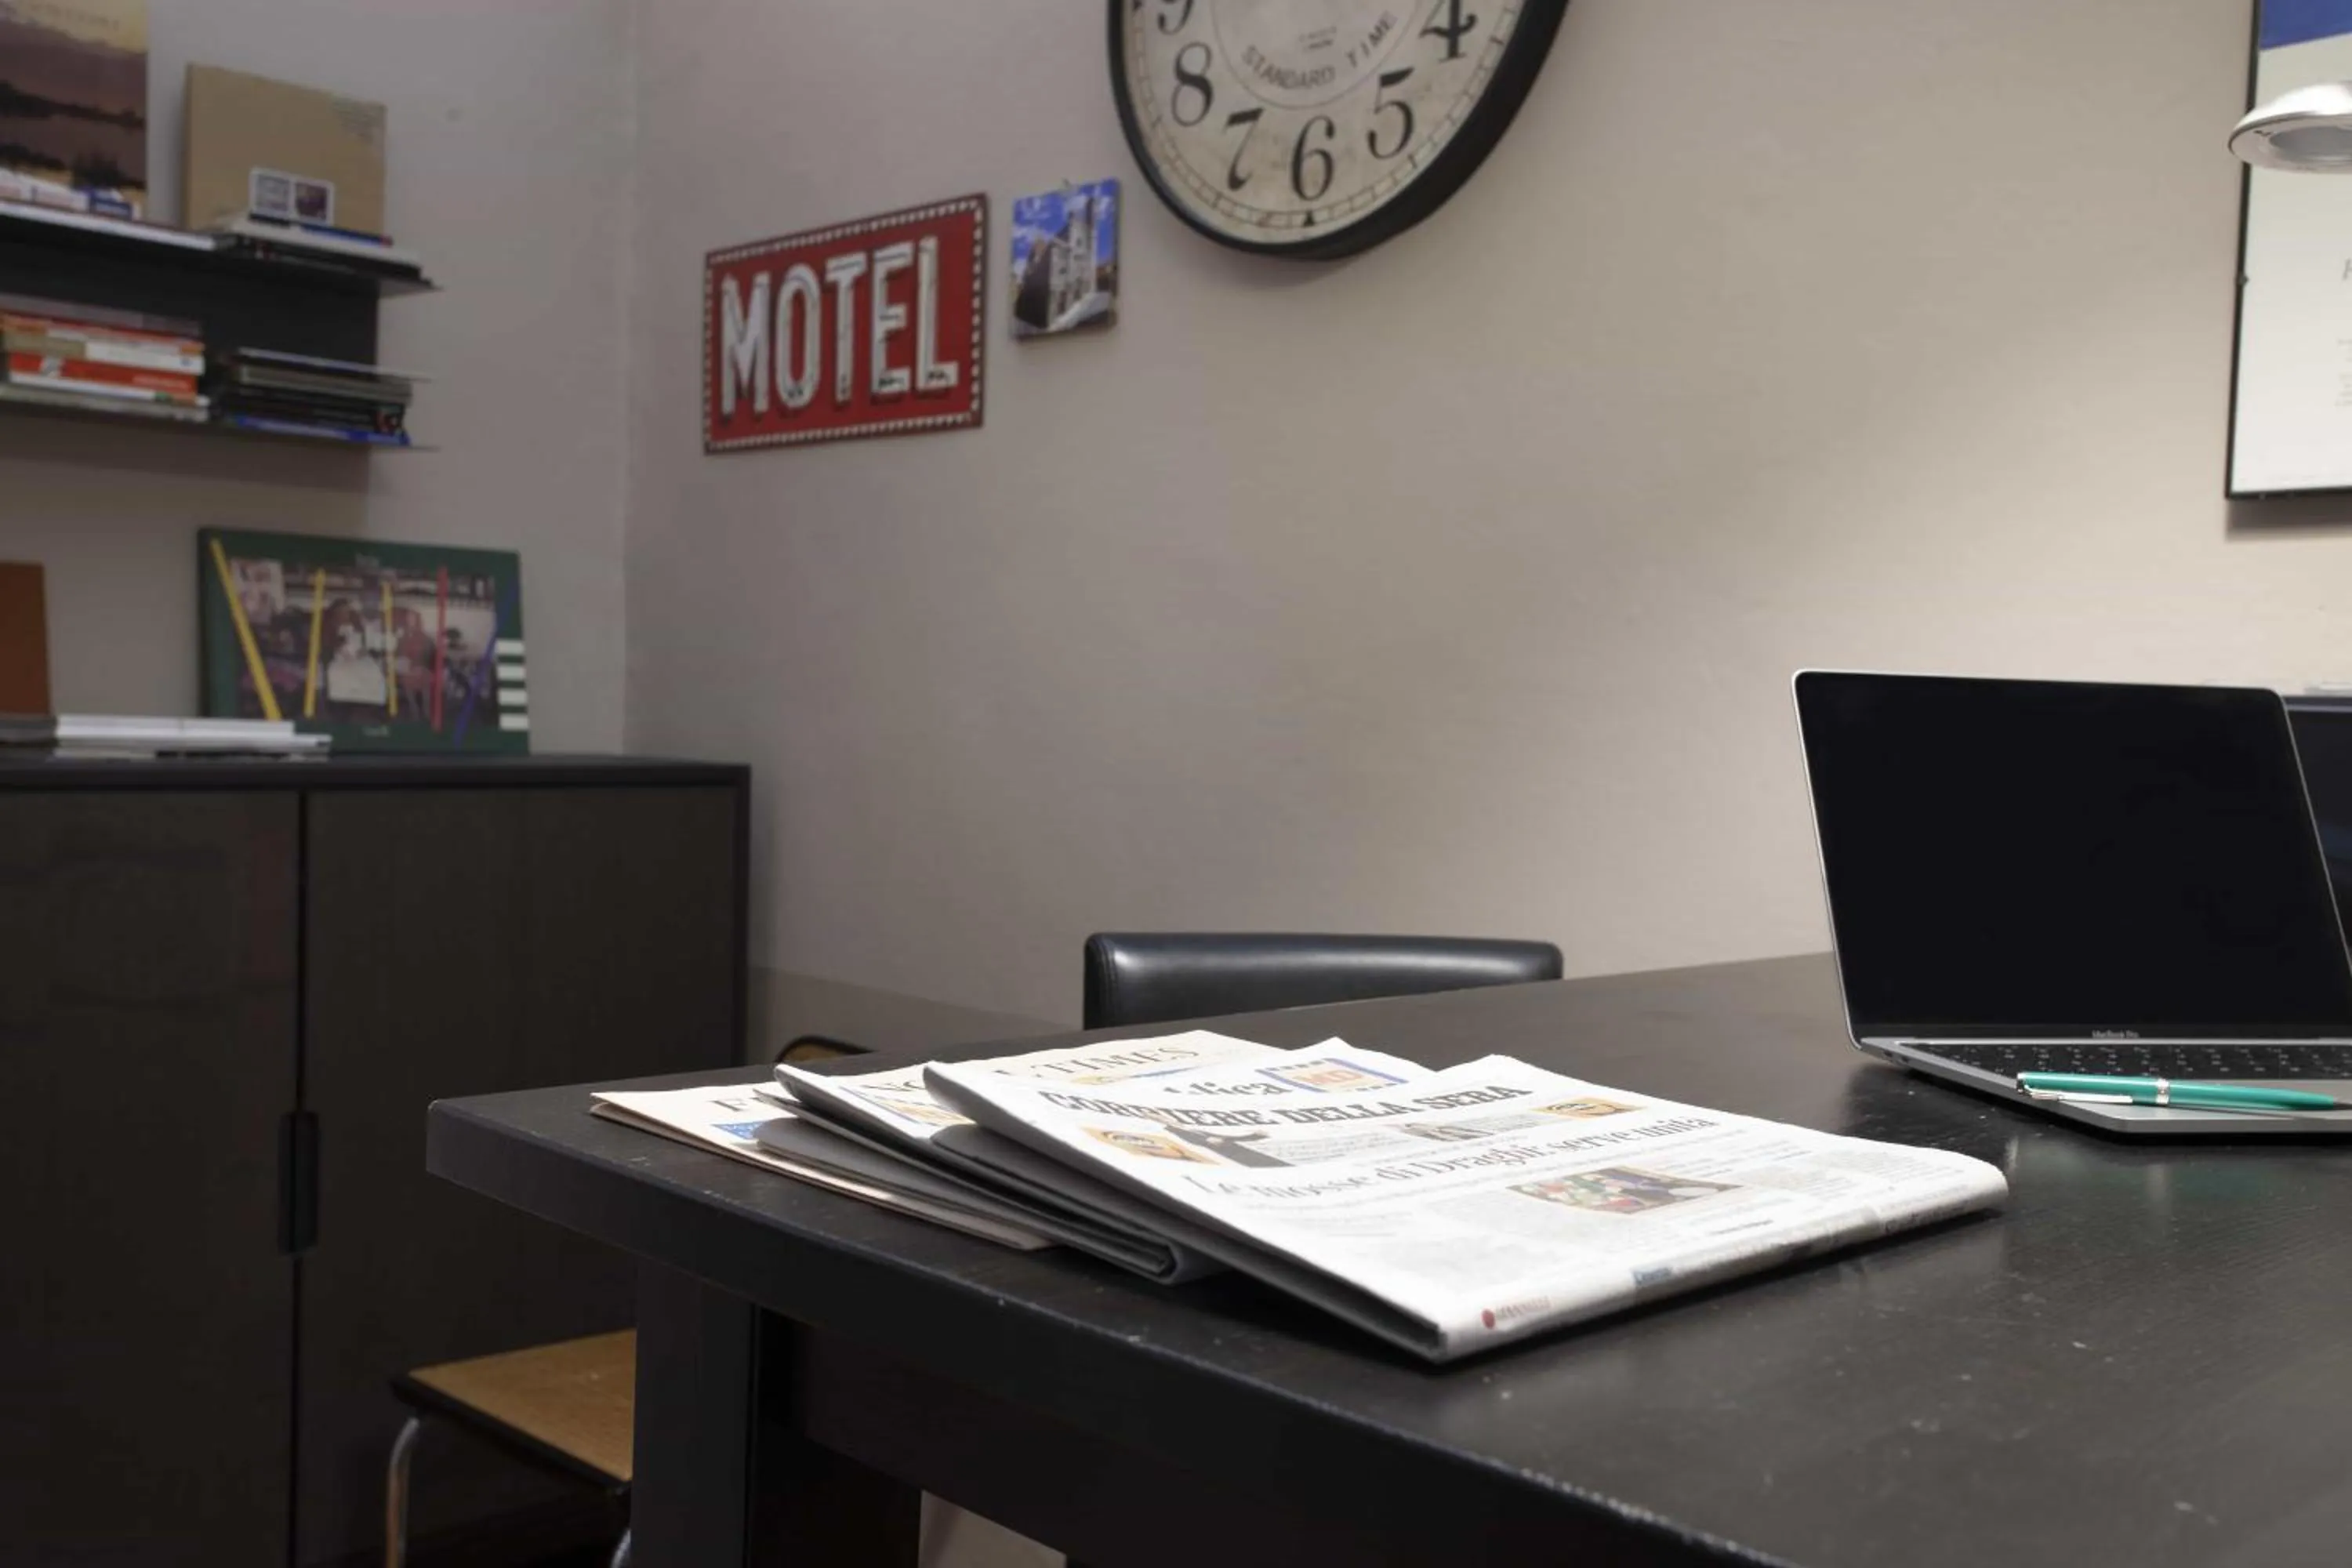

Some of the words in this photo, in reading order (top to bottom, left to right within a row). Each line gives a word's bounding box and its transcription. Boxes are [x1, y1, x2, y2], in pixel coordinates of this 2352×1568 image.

[1241, 45, 1335, 89] STANDARD
[1345, 11, 1398, 68] TIME
[1417, 0, 1477, 63] 4
[1171, 42, 1213, 126] 8
[1367, 67, 1414, 158] 5
[1226, 108, 1264, 191] 7
[1291, 116, 1334, 201] 6
[720, 235, 959, 416] MOTEL
[1044, 1047, 1199, 1073] TIMES
[1272, 1101, 1425, 1124] DELLA
[1412, 1085, 1533, 1109] SERA
[1546, 1131, 1641, 1151] serve
